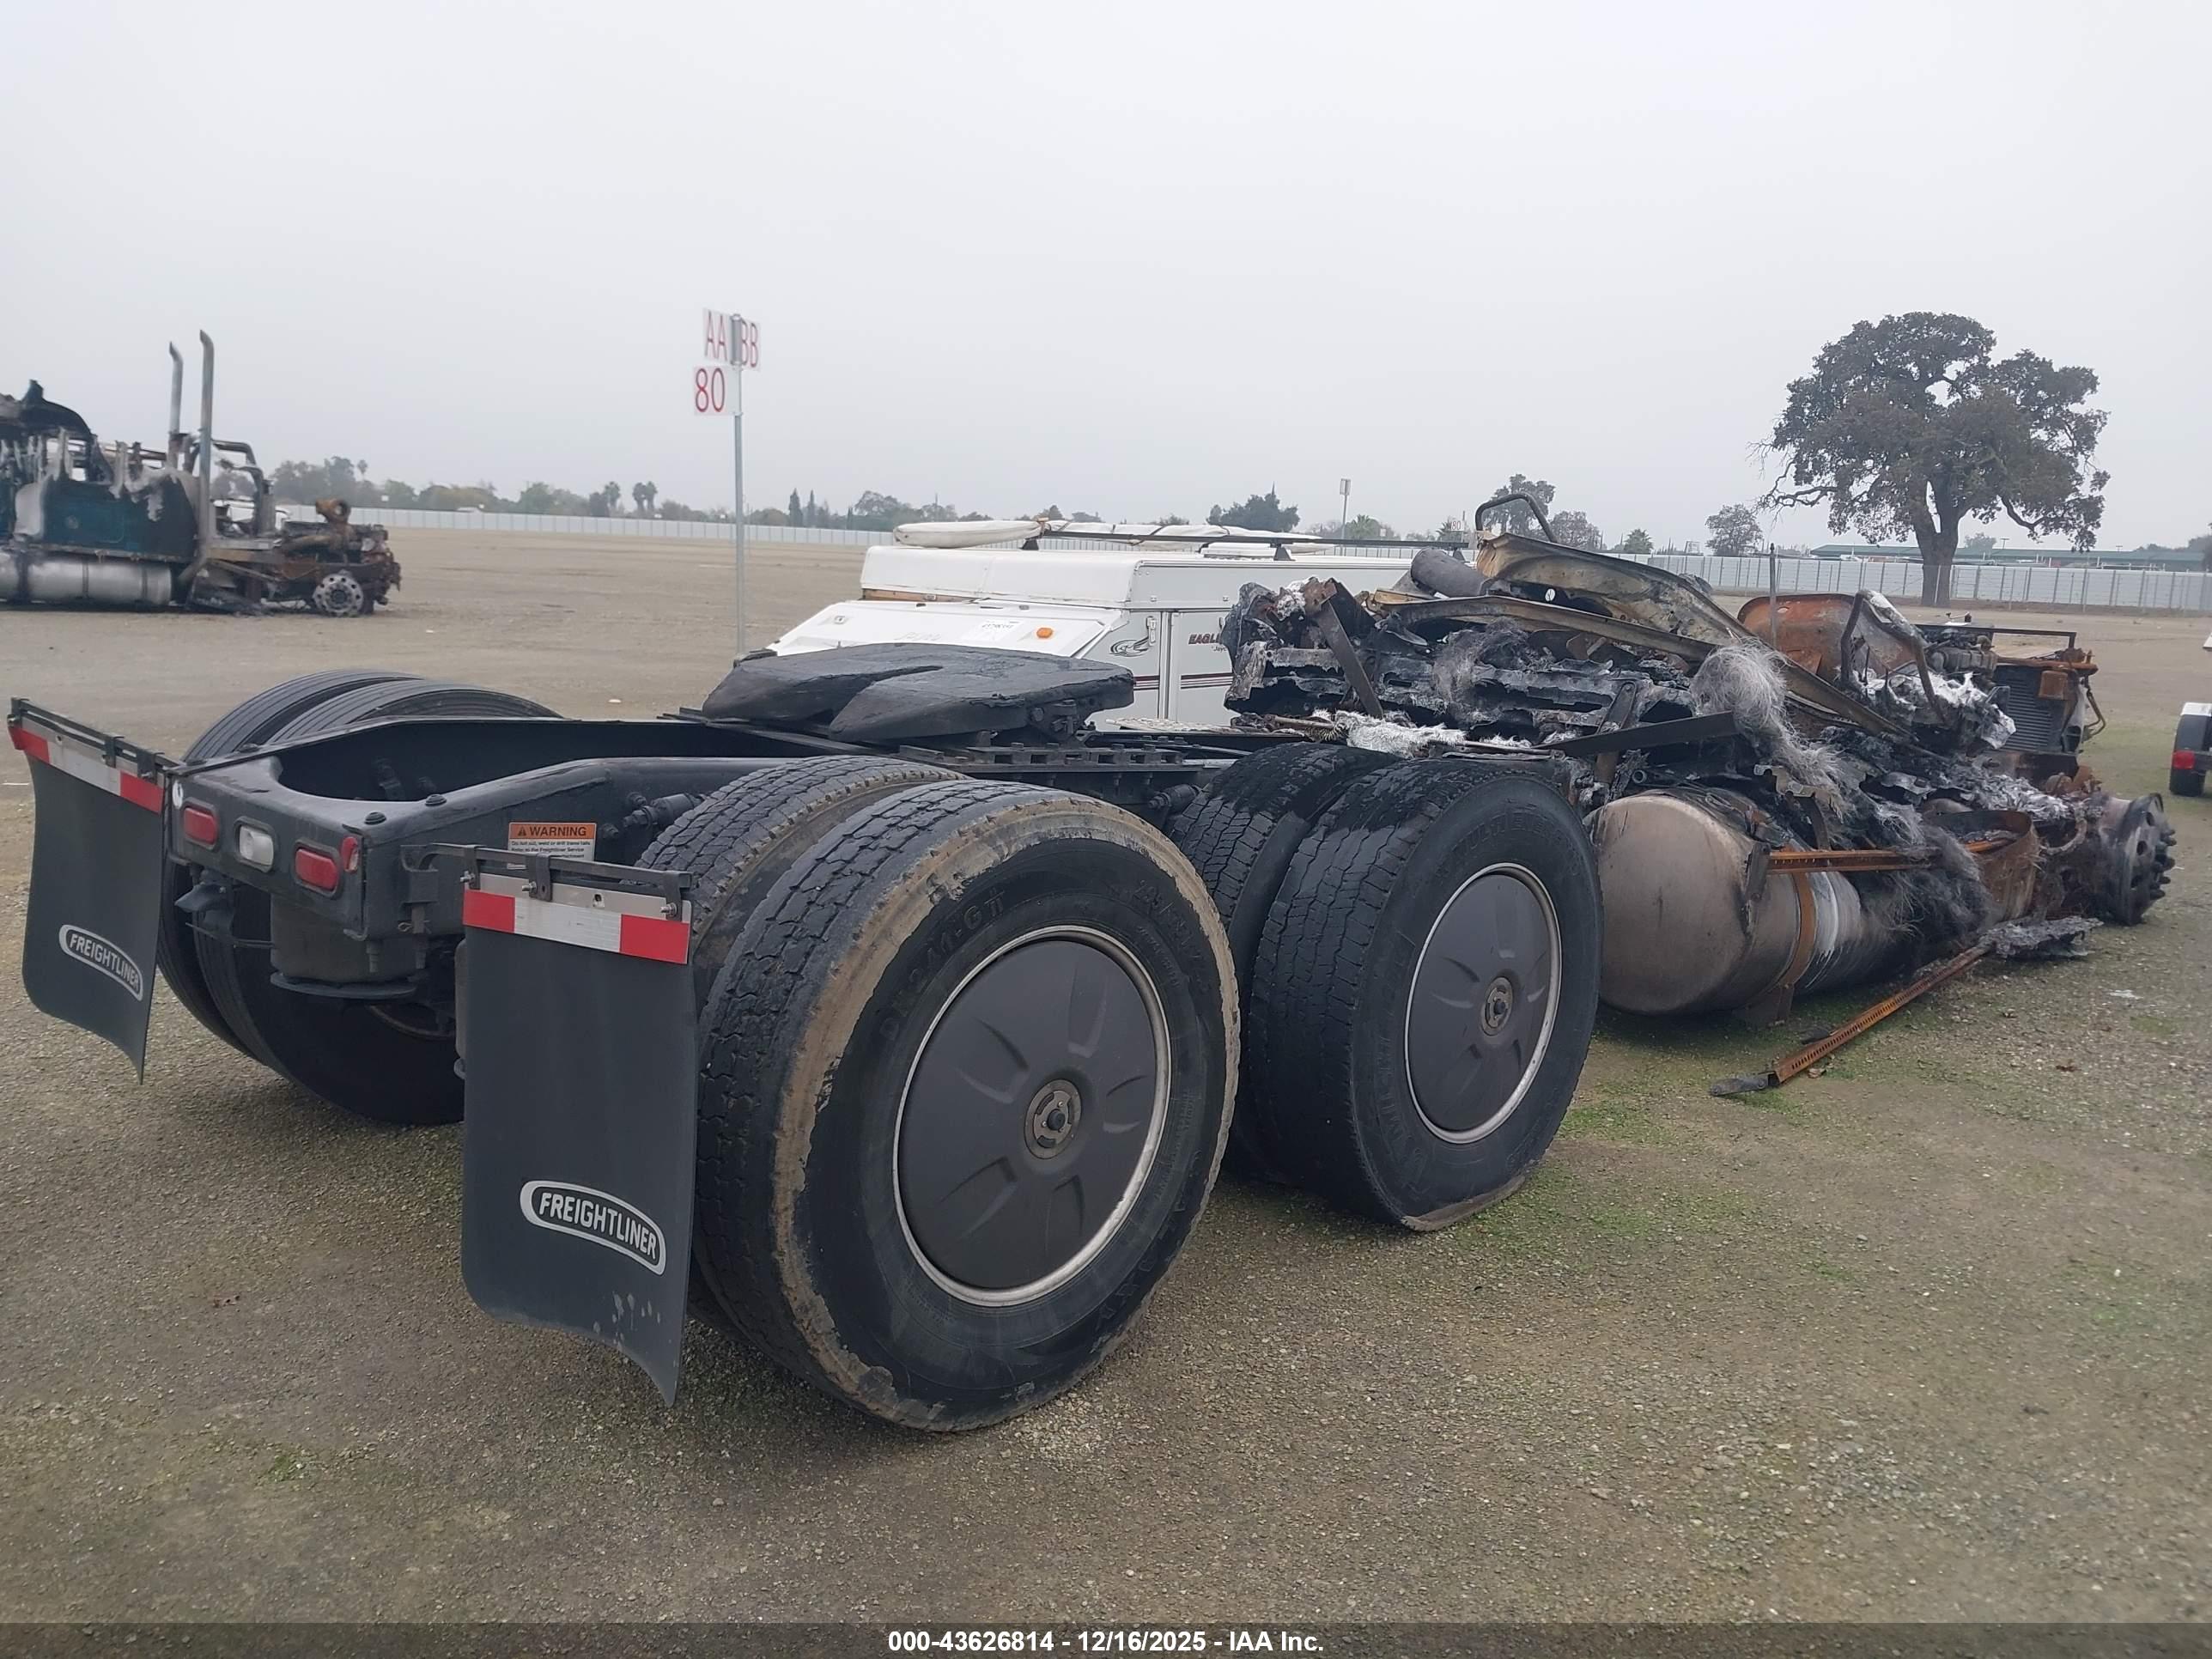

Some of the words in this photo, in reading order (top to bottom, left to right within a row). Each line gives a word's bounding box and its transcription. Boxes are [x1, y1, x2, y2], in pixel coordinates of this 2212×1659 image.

[704, 310, 728, 362] AA
[696, 368, 726, 412] 80
[529, 826, 586, 836] WARNING
[70, 933, 140, 991] FREIGHTLINER
[539, 1192, 658, 1260] FREIGHTLINER
